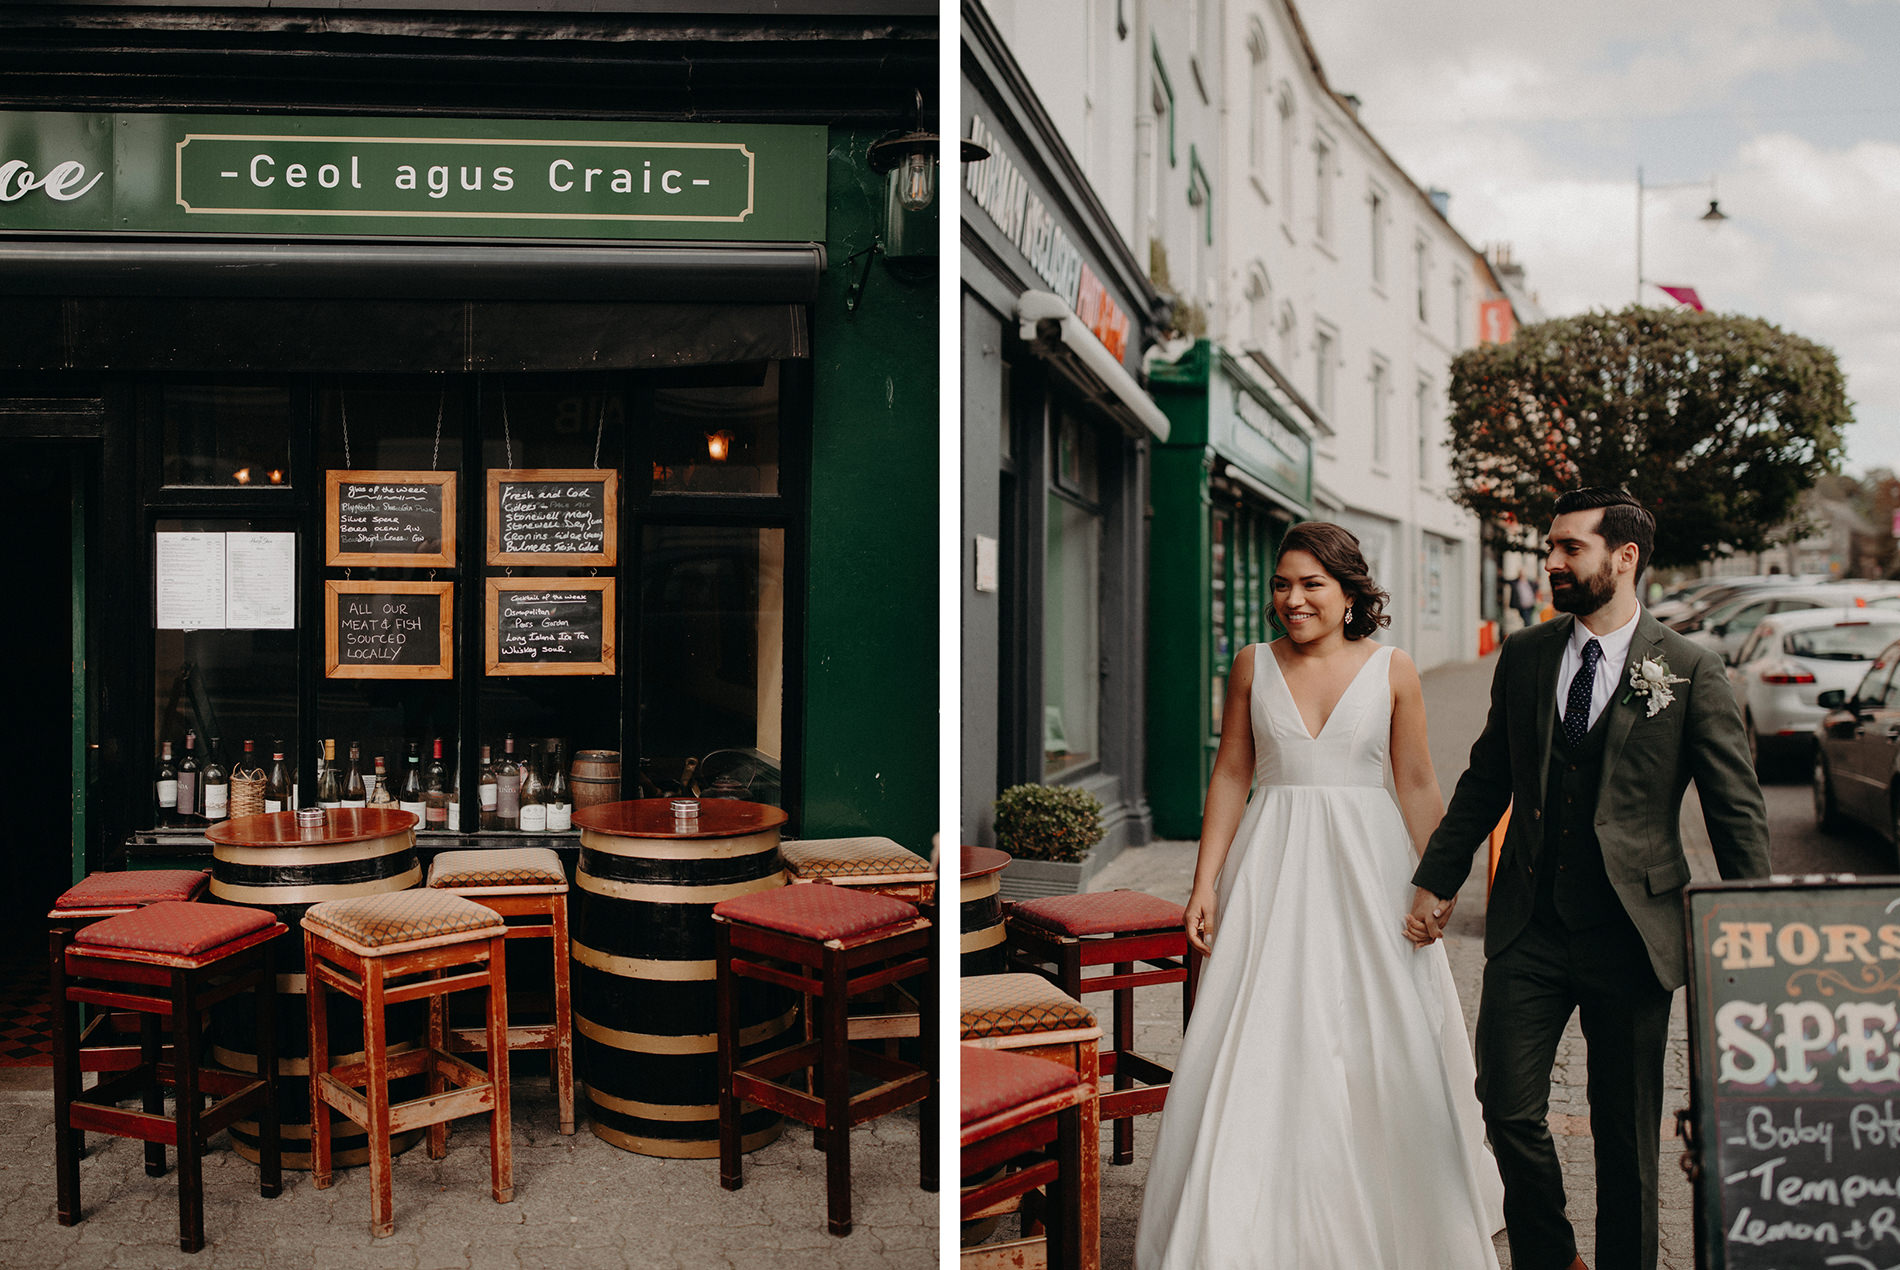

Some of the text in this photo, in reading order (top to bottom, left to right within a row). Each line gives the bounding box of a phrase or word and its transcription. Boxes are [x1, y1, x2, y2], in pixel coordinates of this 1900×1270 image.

[394, 165, 515, 199] agus
[381, 486, 395, 494] the
[502, 486, 535, 506] Fresh
[538, 489, 561, 499] and
[349, 602, 409, 616] ALL OUR
[341, 616, 422, 631] MEAT & FISH
[505, 632, 527, 645] Long
[528, 632, 556, 641] Island
[573, 631, 590, 640] Tea
[346, 646, 402, 661] LOCALLY
[1714, 999, 1900, 1085] SPE
[1849, 1099, 1900, 1150] Pot
[1723, 1156, 1900, 1208] -Tempu
[1727, 1206, 1840, 1246] Lemon
